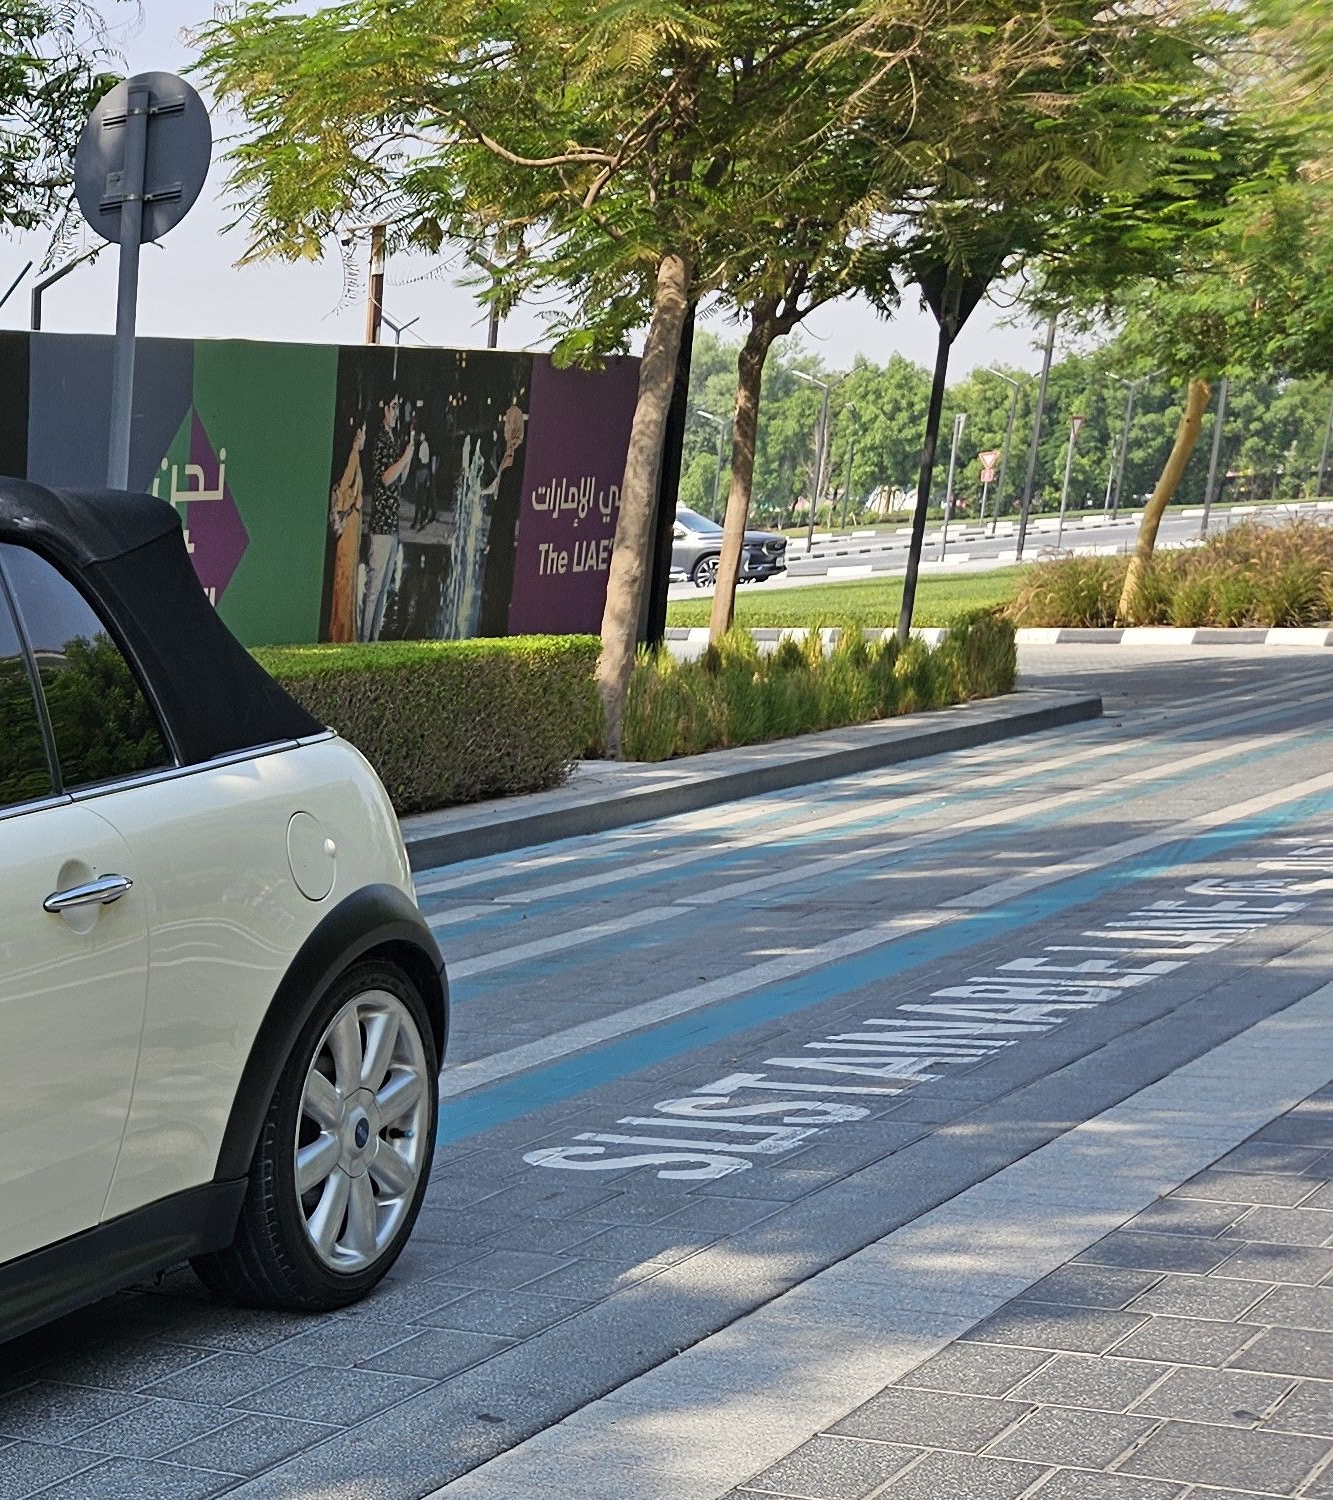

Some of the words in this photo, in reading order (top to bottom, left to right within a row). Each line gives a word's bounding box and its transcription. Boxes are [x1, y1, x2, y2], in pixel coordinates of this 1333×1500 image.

[539, 543, 568, 575] The
[523, 957, 1190, 1180] SUSTAINABLE
[1043, 900, 1311, 954] LANE
